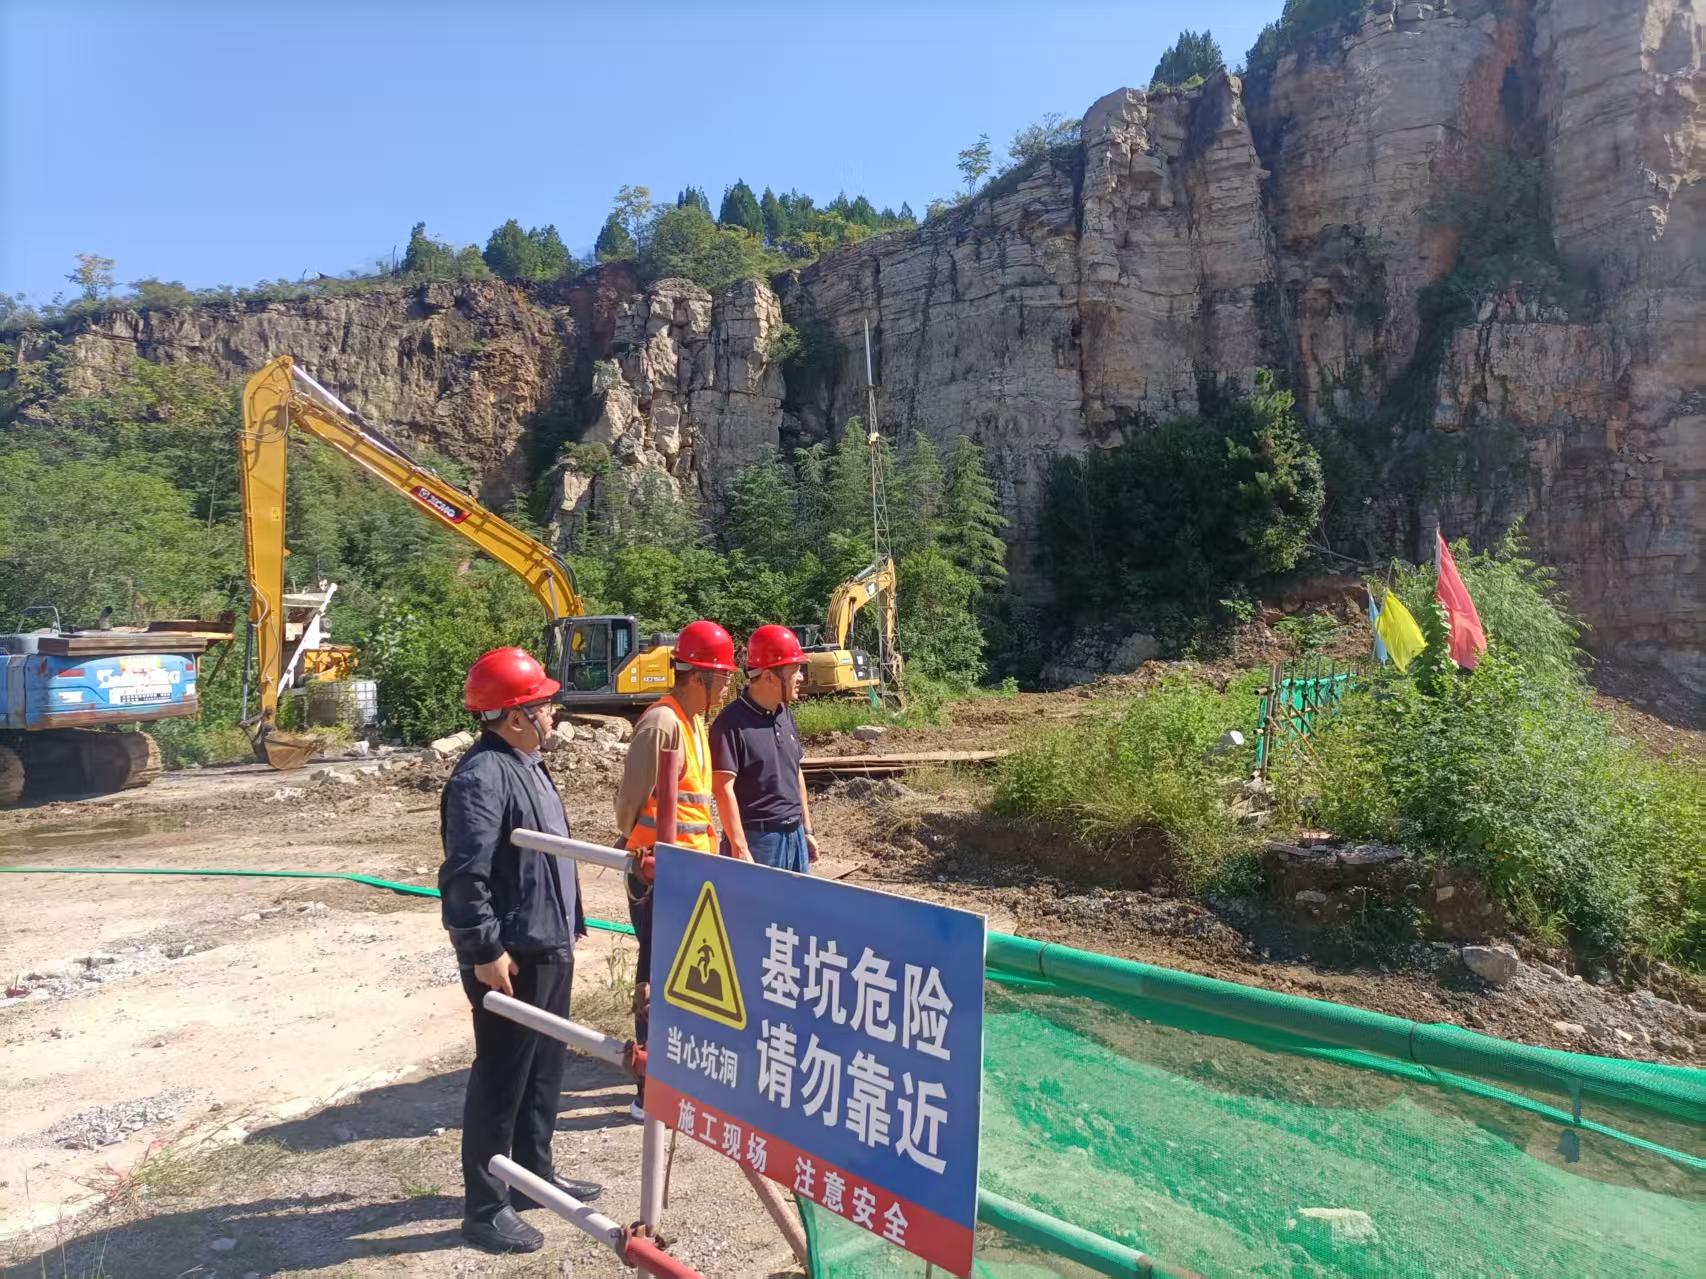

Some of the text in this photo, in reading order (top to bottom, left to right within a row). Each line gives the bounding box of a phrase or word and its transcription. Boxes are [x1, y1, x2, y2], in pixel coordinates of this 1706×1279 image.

[667, 1025, 738, 1089] 当心坑洞
[761, 922, 953, 1061] 基坑危险
[756, 1019, 948, 1175] 请勿靠近
[677, 1099, 909, 1248] 施工现场 注意安全
